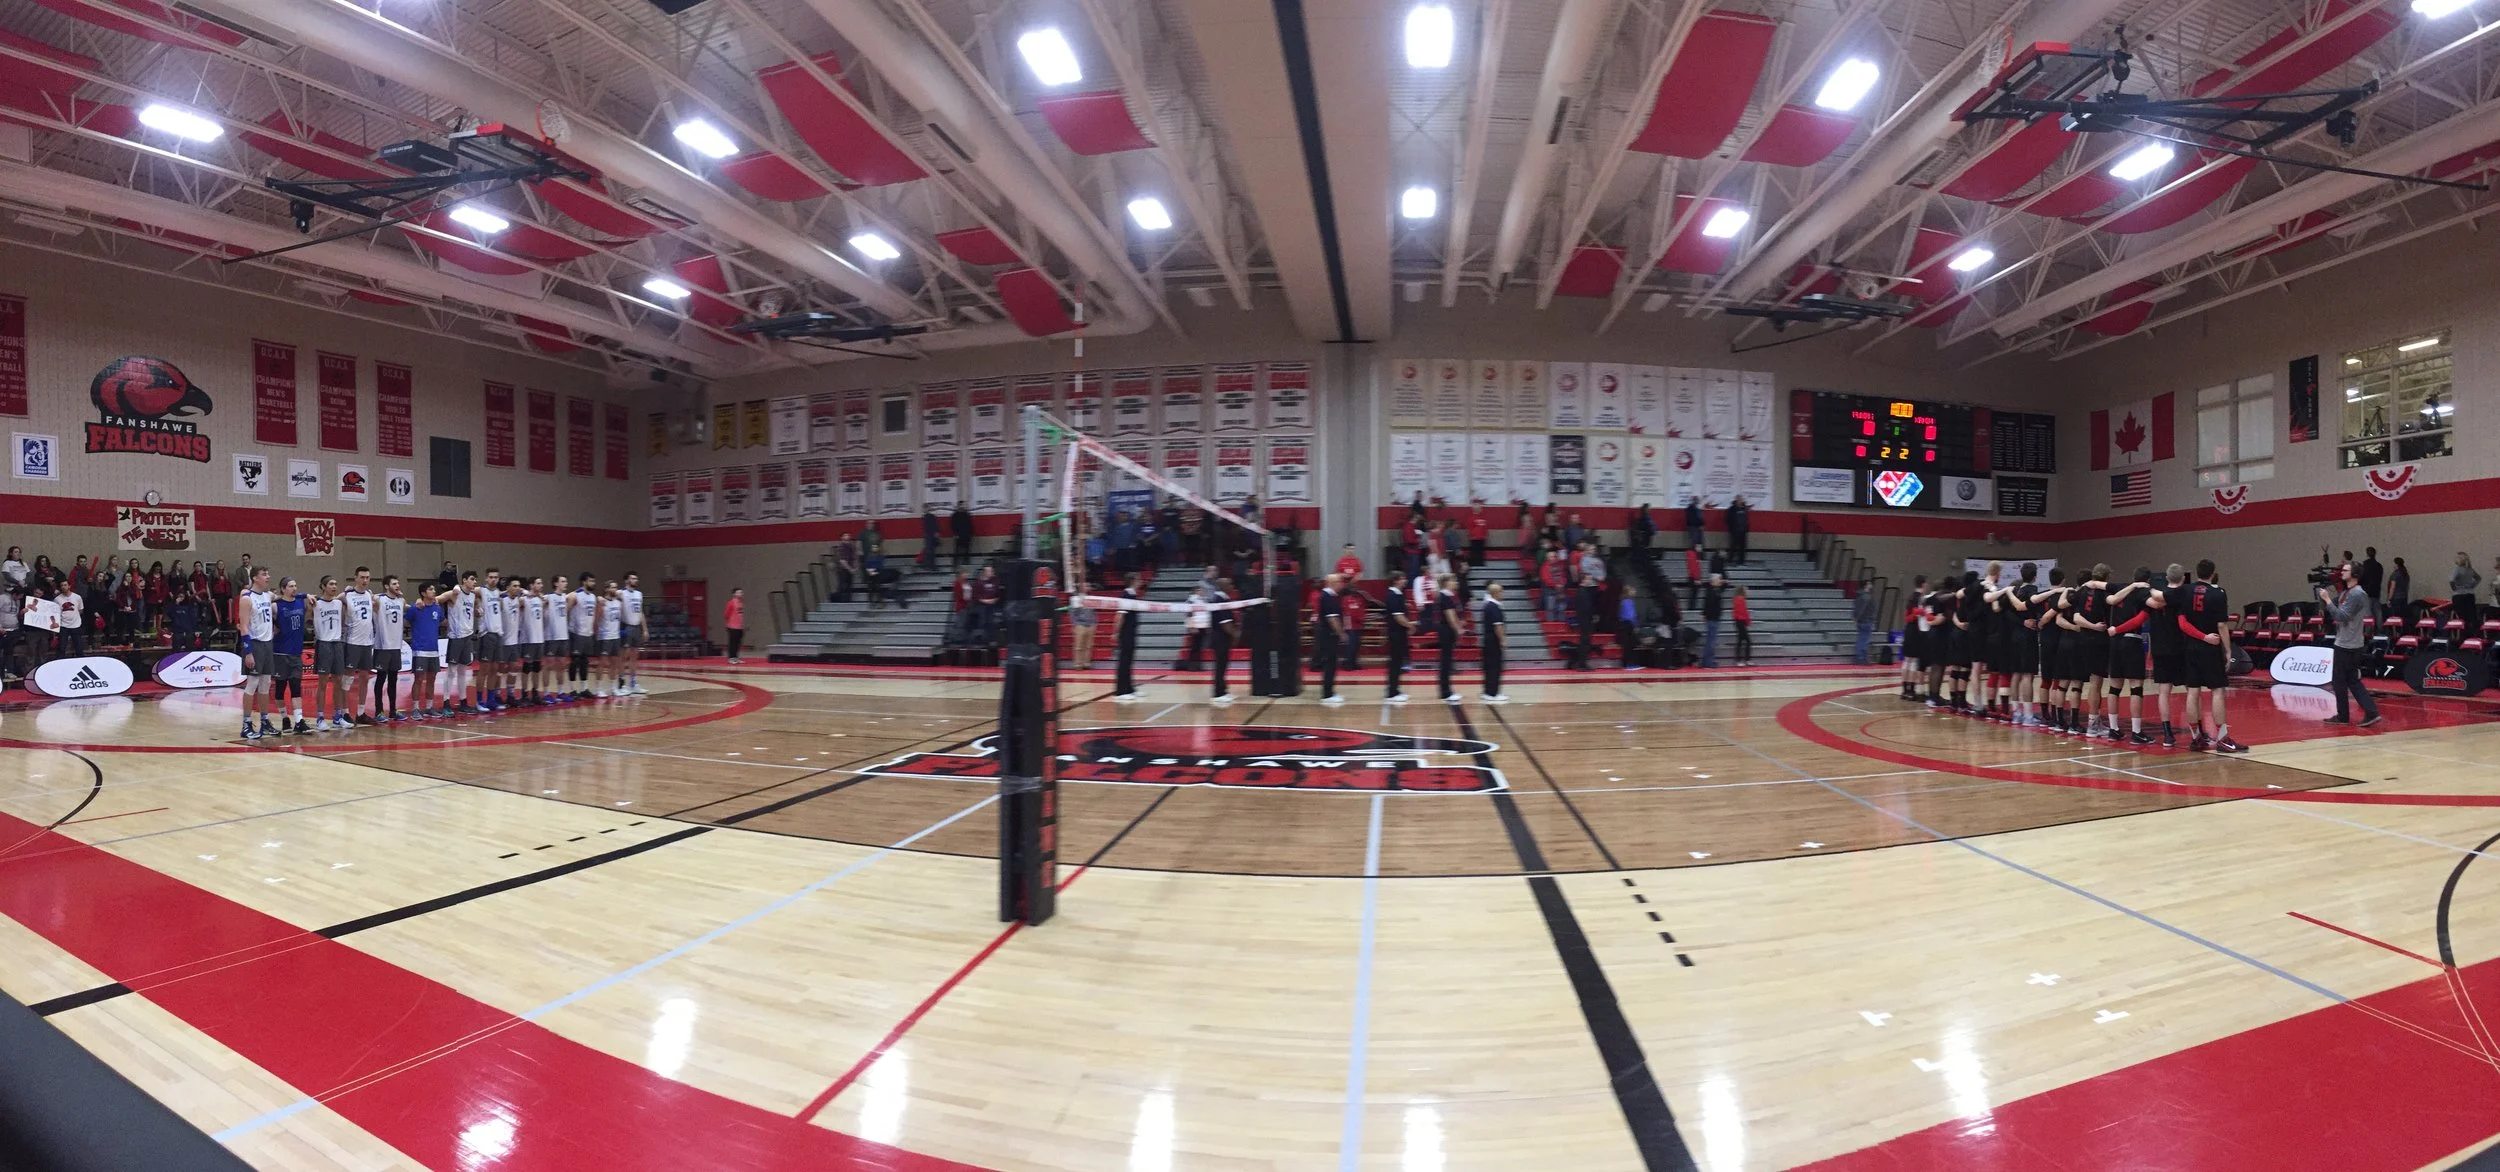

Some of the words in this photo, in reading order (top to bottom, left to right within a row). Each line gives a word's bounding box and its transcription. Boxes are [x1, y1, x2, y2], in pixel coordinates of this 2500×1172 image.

[106, 416, 193, 433] FANSHAWE
[88, 425, 209, 461] FALCONS
[1880, 446, 1891, 458] 2
[1899, 448, 1910, 460] 2
[132, 508, 190, 526] PROTECT
[121, 525, 144, 544] THE
[146, 528, 187, 544] NEST
[262, 609, 270, 623] 15
[360, 607, 367, 620] 2
[391, 611, 398, 623] 3
[329, 616, 333, 630] 1
[2281, 656, 2328, 674] Canada
[69, 679, 109, 690] adidas
[1055, 754, 1396, 768] ANSHAWE
